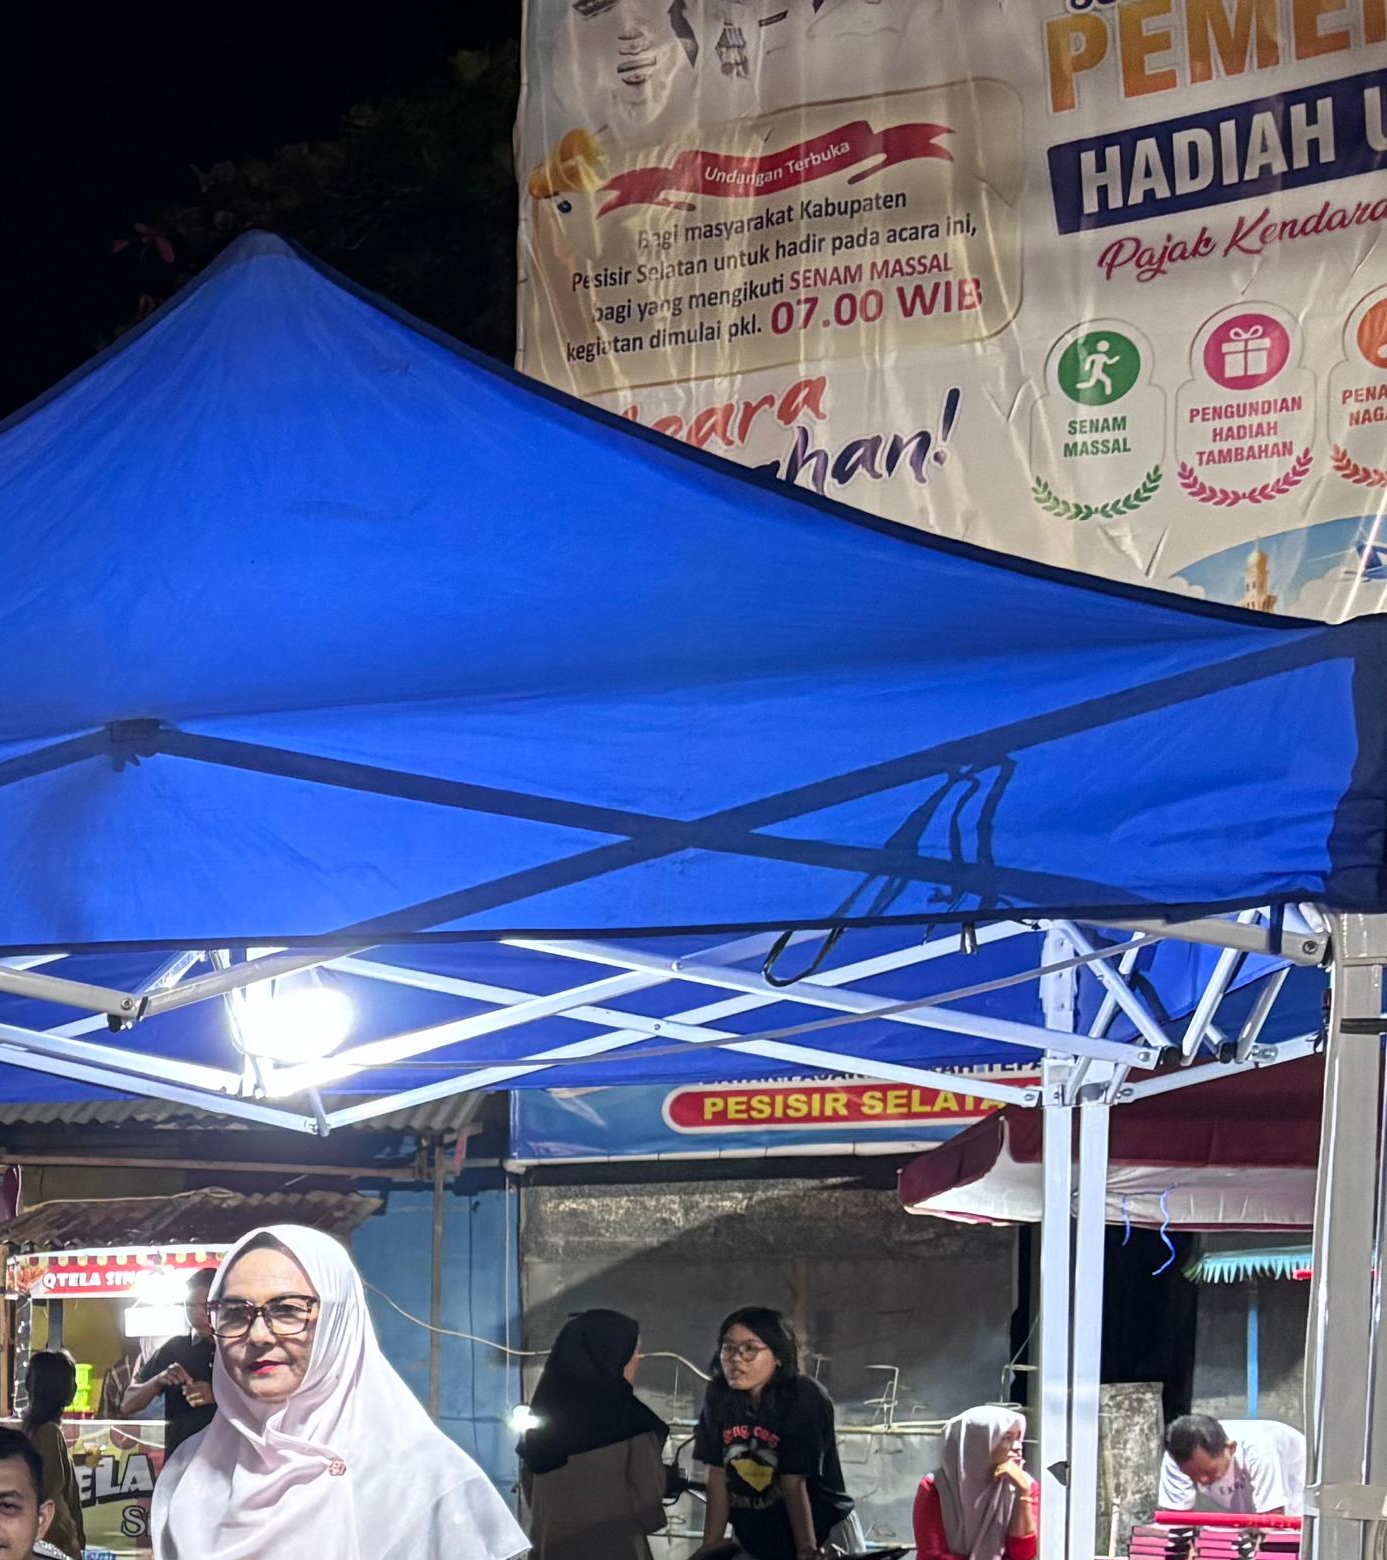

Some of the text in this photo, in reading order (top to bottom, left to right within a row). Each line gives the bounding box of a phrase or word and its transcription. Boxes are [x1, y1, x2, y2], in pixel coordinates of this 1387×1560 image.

[704, 140, 851, 187] Undangan Terbuka
[1079, 96, 1336, 215] HADIAH
[638, 191, 907, 251] Bagi masyarakat Kabupaten
[572, 212, 978, 292] Pesisir Selatan untuk hadir pada acara ini,
[1097, 227, 1216, 282] Pajak
[637, 293, 683, 321] yang
[688, 275, 786, 309] mengikuti
[789, 261, 864, 291] SENAM
[869, 251, 954, 282] MASSAL
[565, 276, 984, 363] kegiatan dimulai pkl. 07.00 WIB
[1189, 395, 1303, 424] PENGUNDIAN
[1349, 405, 1387, 428] NAG
[1067, 415, 1127, 436] SENAM
[1212, 420, 1279, 443] HADIAH
[1063, 436, 1132, 458] MASSAL
[1196, 440, 1294, 467] TAMBAHAN
[703, 1092, 848, 1120] PESISIR
[43, 1269, 143, 1290] QTELA SIN
